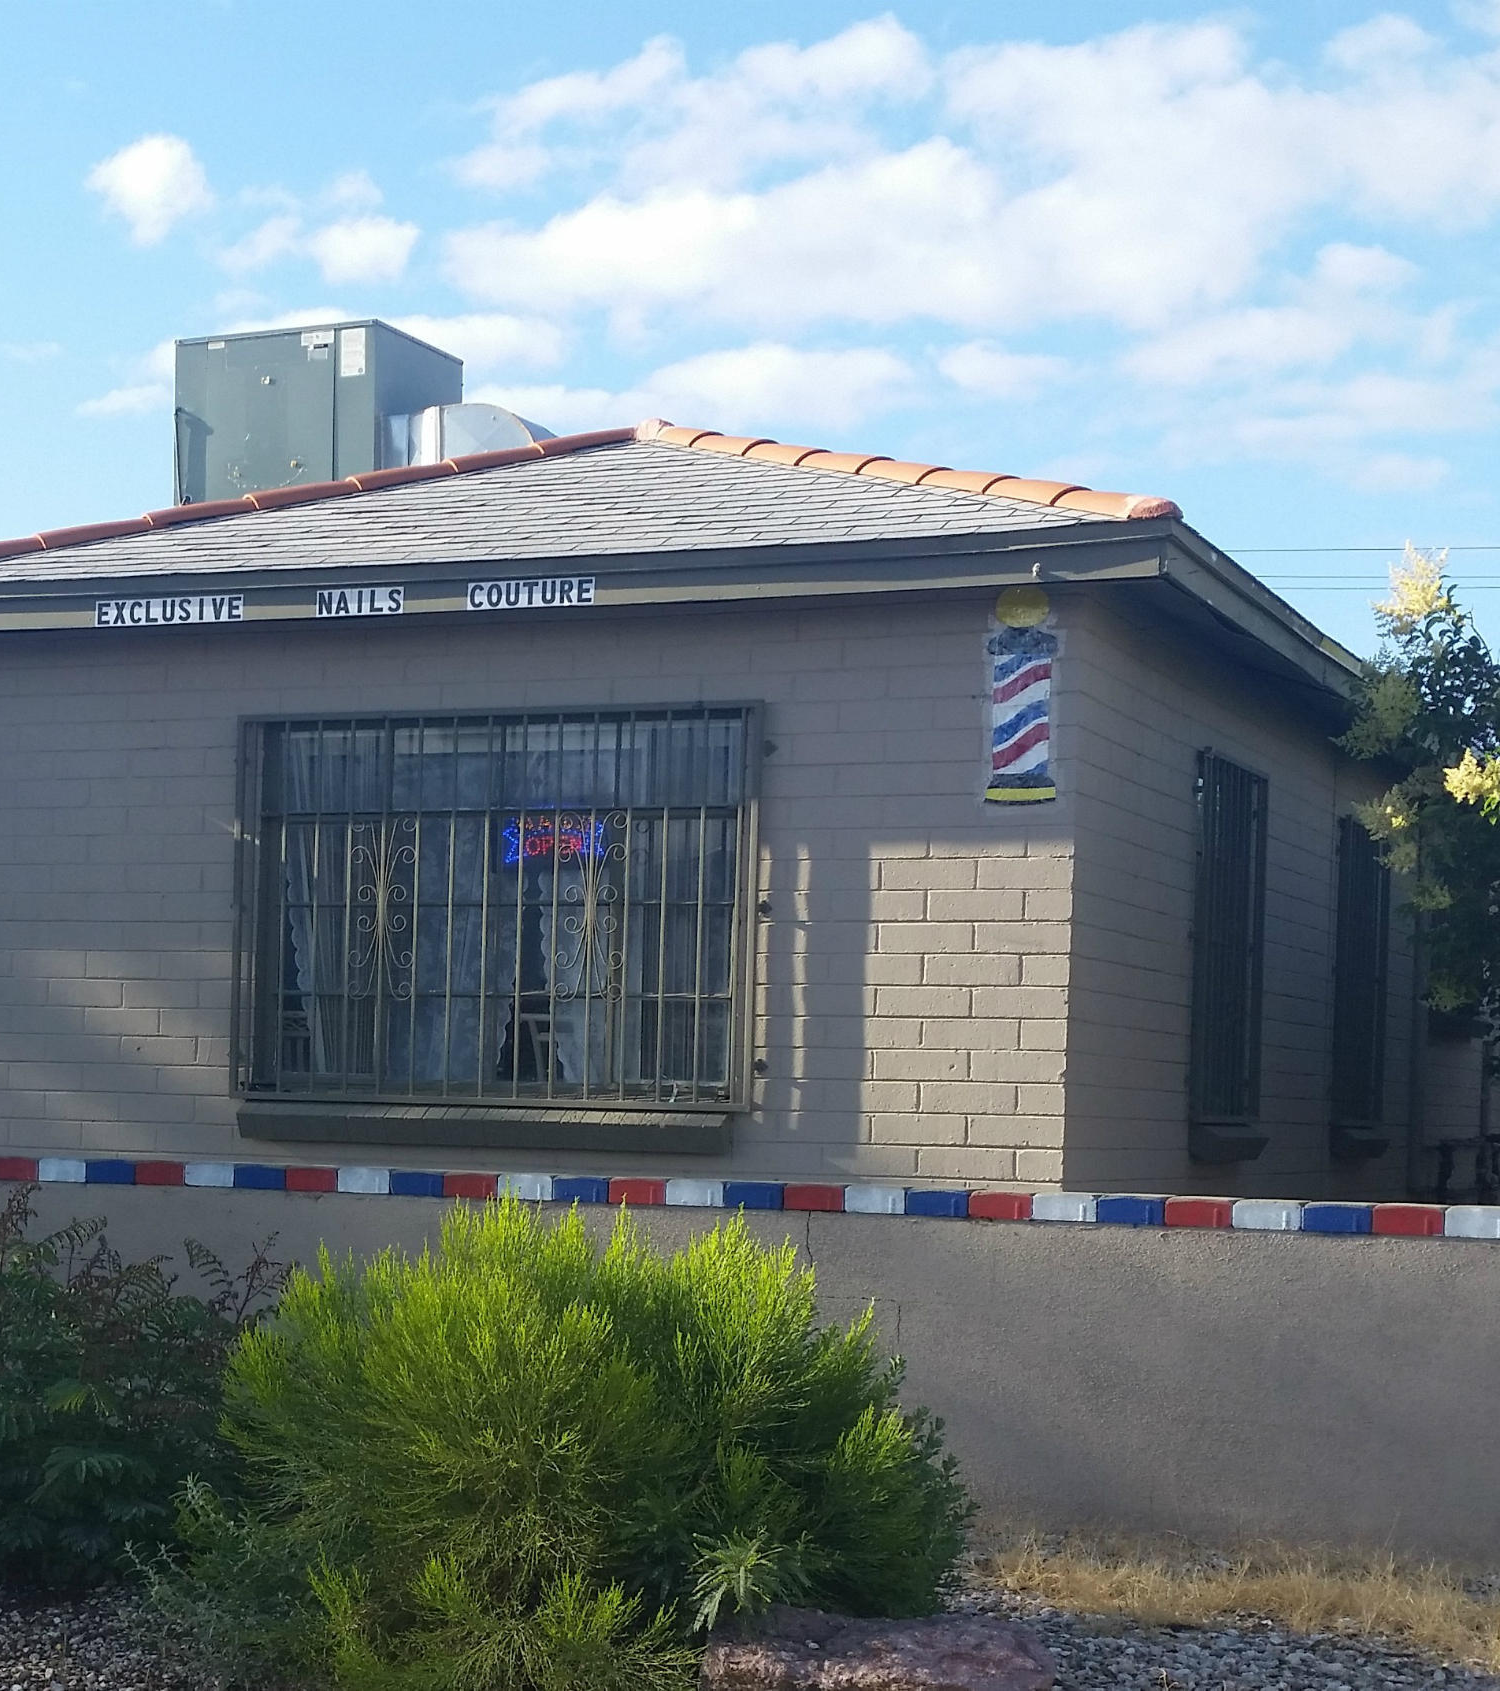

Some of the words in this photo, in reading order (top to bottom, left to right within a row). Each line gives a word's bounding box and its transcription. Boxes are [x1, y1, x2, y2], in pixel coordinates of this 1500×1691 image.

[97, 596, 242, 626] EXCLUSIVE
[317, 588, 402, 615] NAILS
[468, 578, 593, 609] COUTURE
